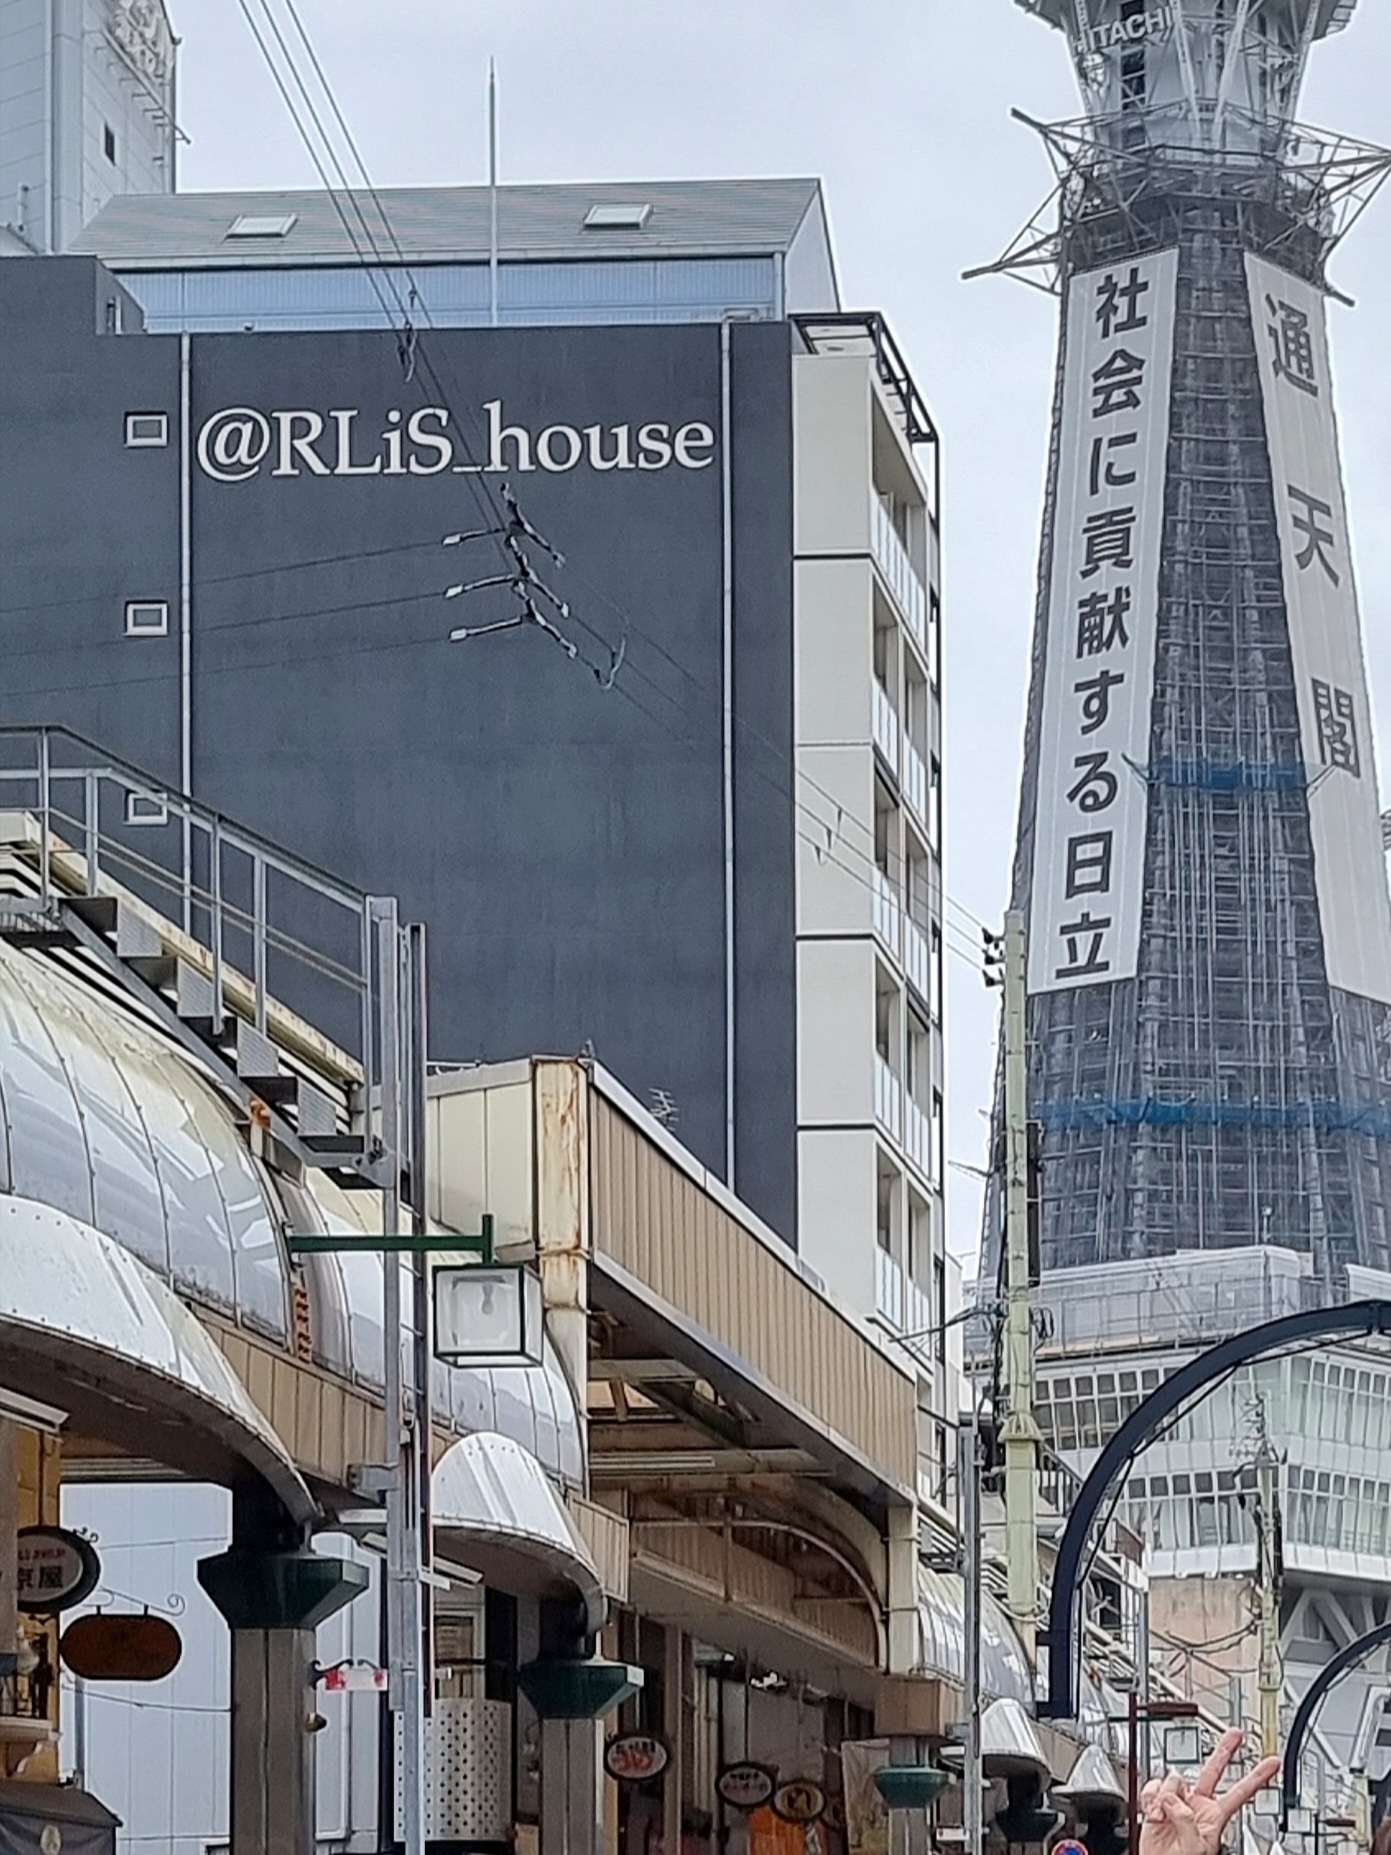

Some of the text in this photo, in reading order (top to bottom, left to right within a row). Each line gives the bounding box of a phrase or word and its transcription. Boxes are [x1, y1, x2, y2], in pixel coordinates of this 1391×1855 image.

[197, 400, 715, 481] @RLiS_house
[1056, 266, 1150, 980] 社会に貢献する日立
[1265, 293, 1361, 779] 通天閣
